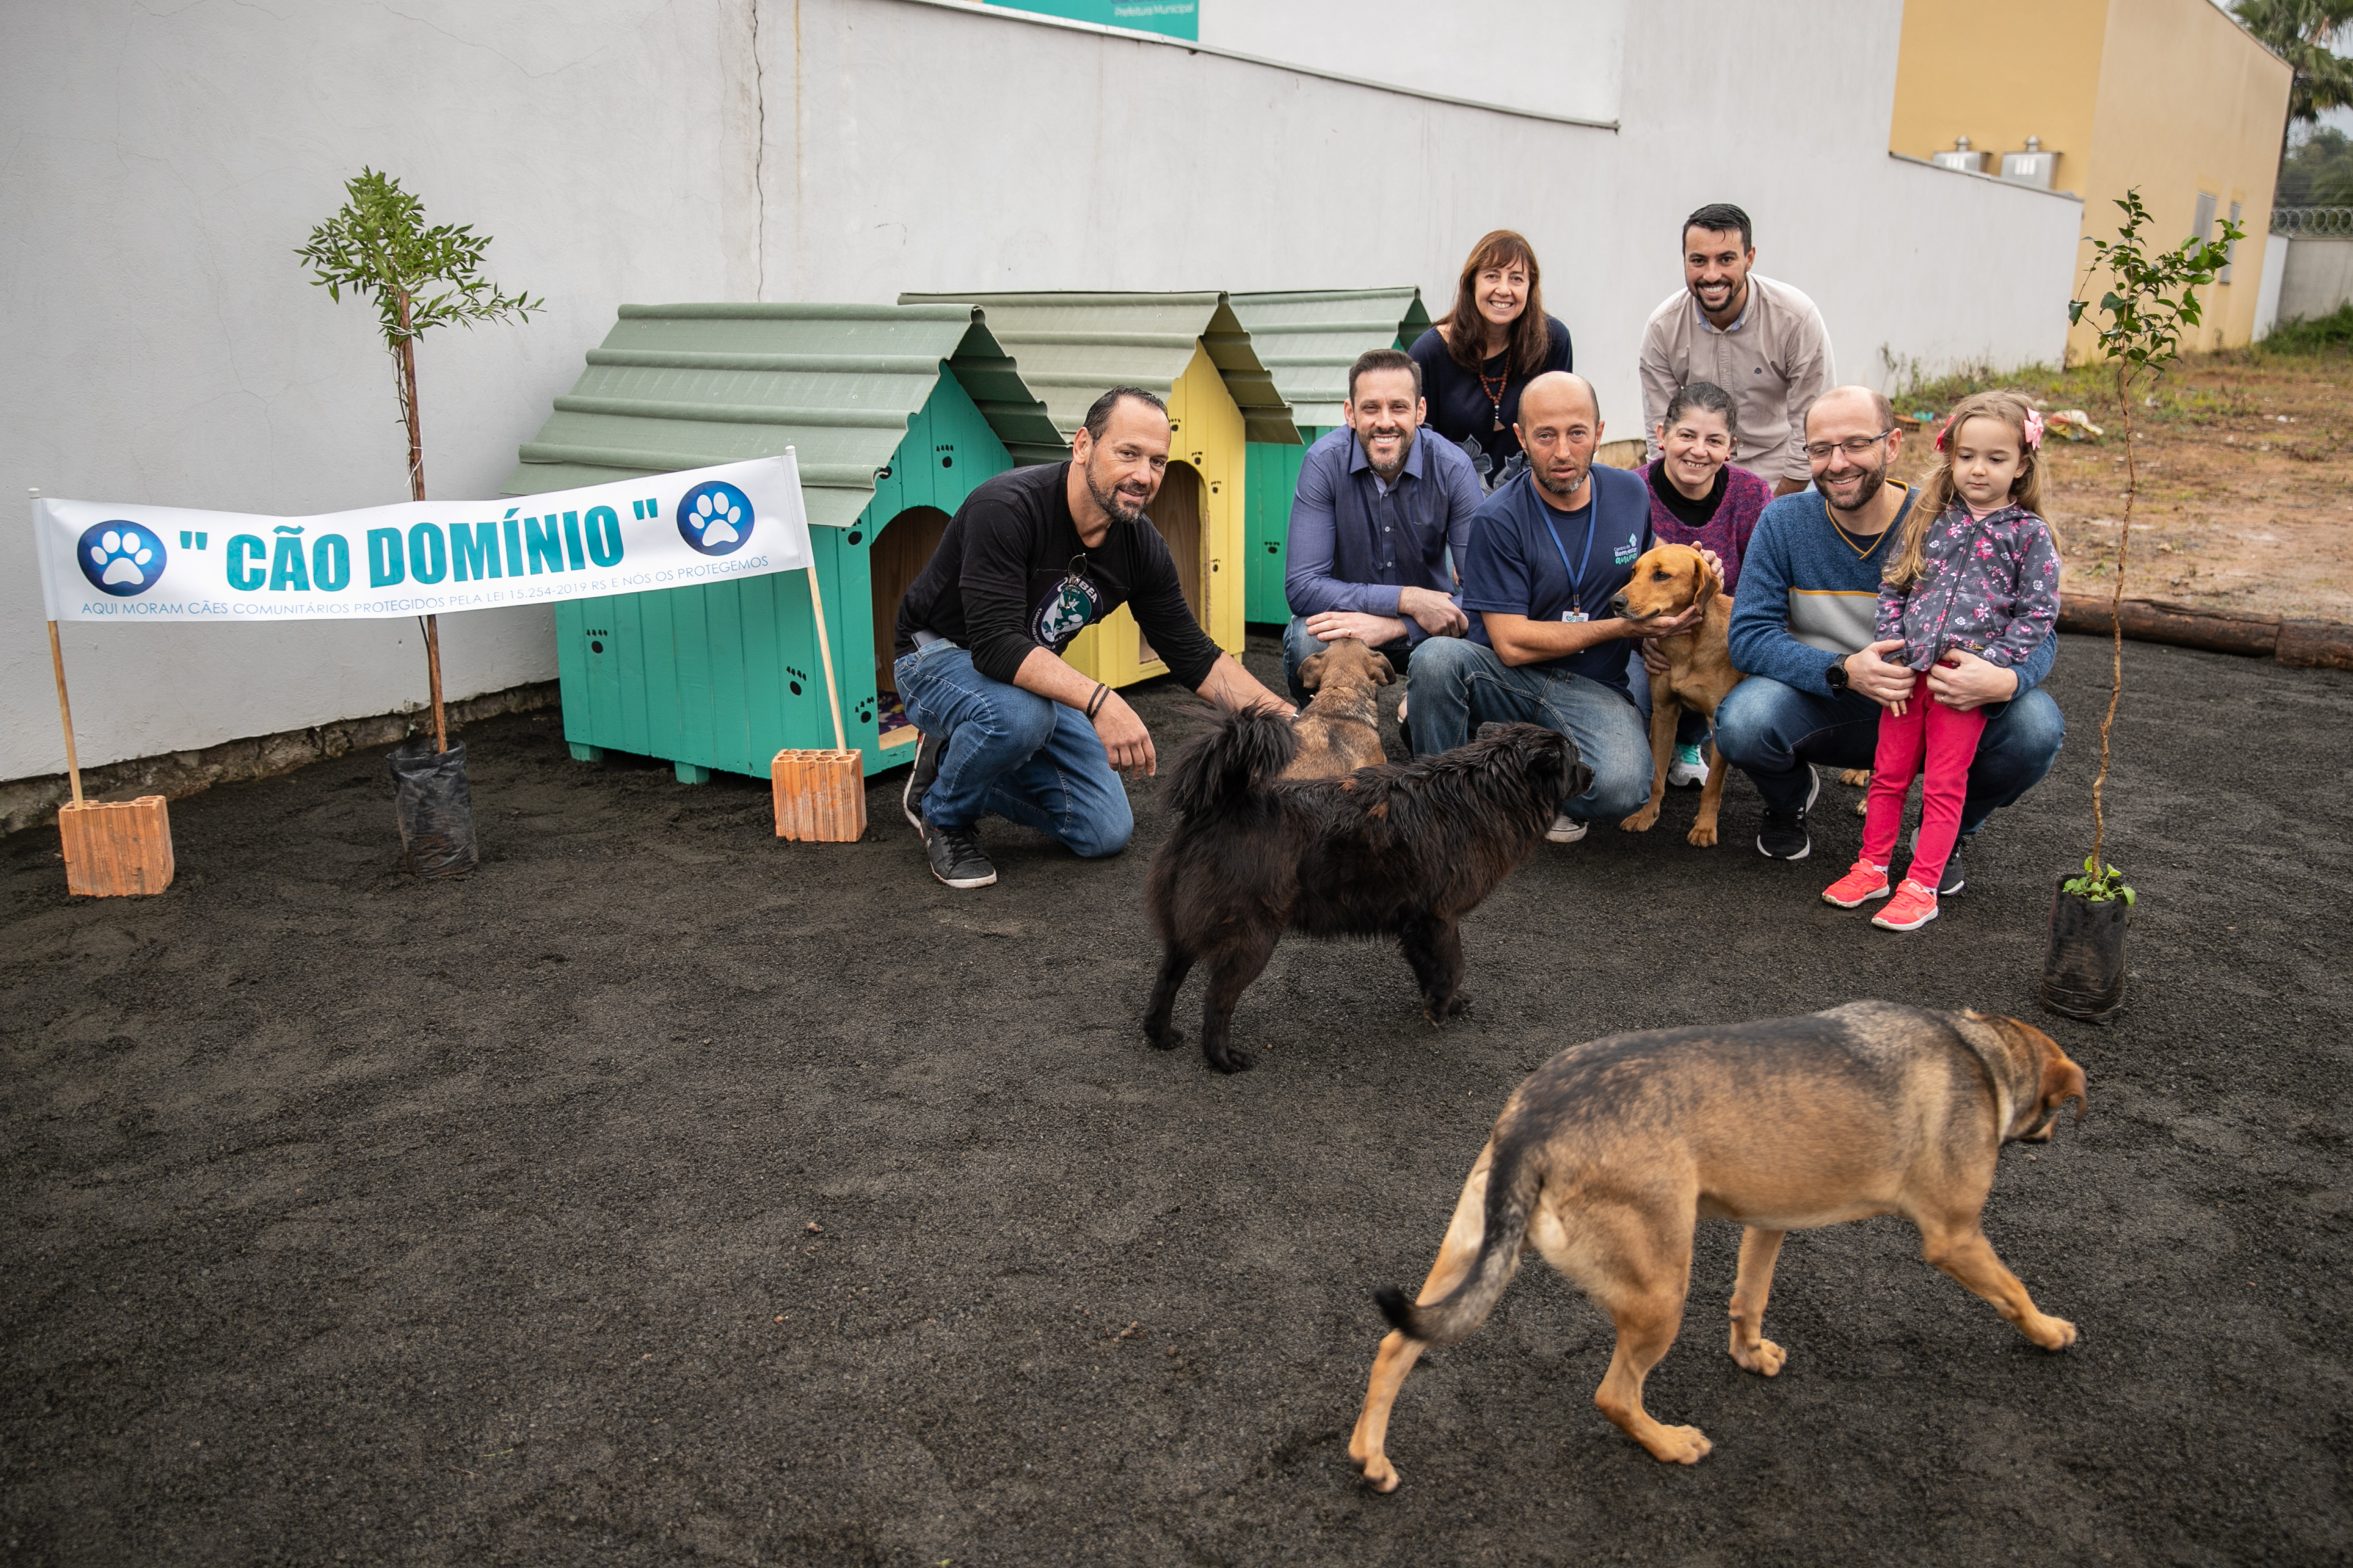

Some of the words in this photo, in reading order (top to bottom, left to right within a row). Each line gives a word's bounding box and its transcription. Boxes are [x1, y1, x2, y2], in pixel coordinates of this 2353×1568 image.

[1153, 3, 1195, 15] Municipal
[226, 525, 350, 592] CÃO
[367, 505, 624, 588] DOMÍNIO
[81, 602, 118, 615] AQUI
[122, 602, 184, 614] MORAM
[188, 600, 228, 614] CÃES
[233, 602, 349, 615] COMUNITÁRIOS
[354, 597, 445, 613] PROTEGIDOS
[450, 594, 482, 606] PELA
[487, 591, 504, 602] LEI
[510, 582, 587, 599] 15.254-2019
[592, 580, 606, 590] RS
[611, 578, 619, 587] E
[623, 573, 651, 586] NÓS
[655, 570, 674, 581] OS
[678, 556, 768, 579] PROTEGEMOS
[1032, 608, 1042, 635] CONSELHO
